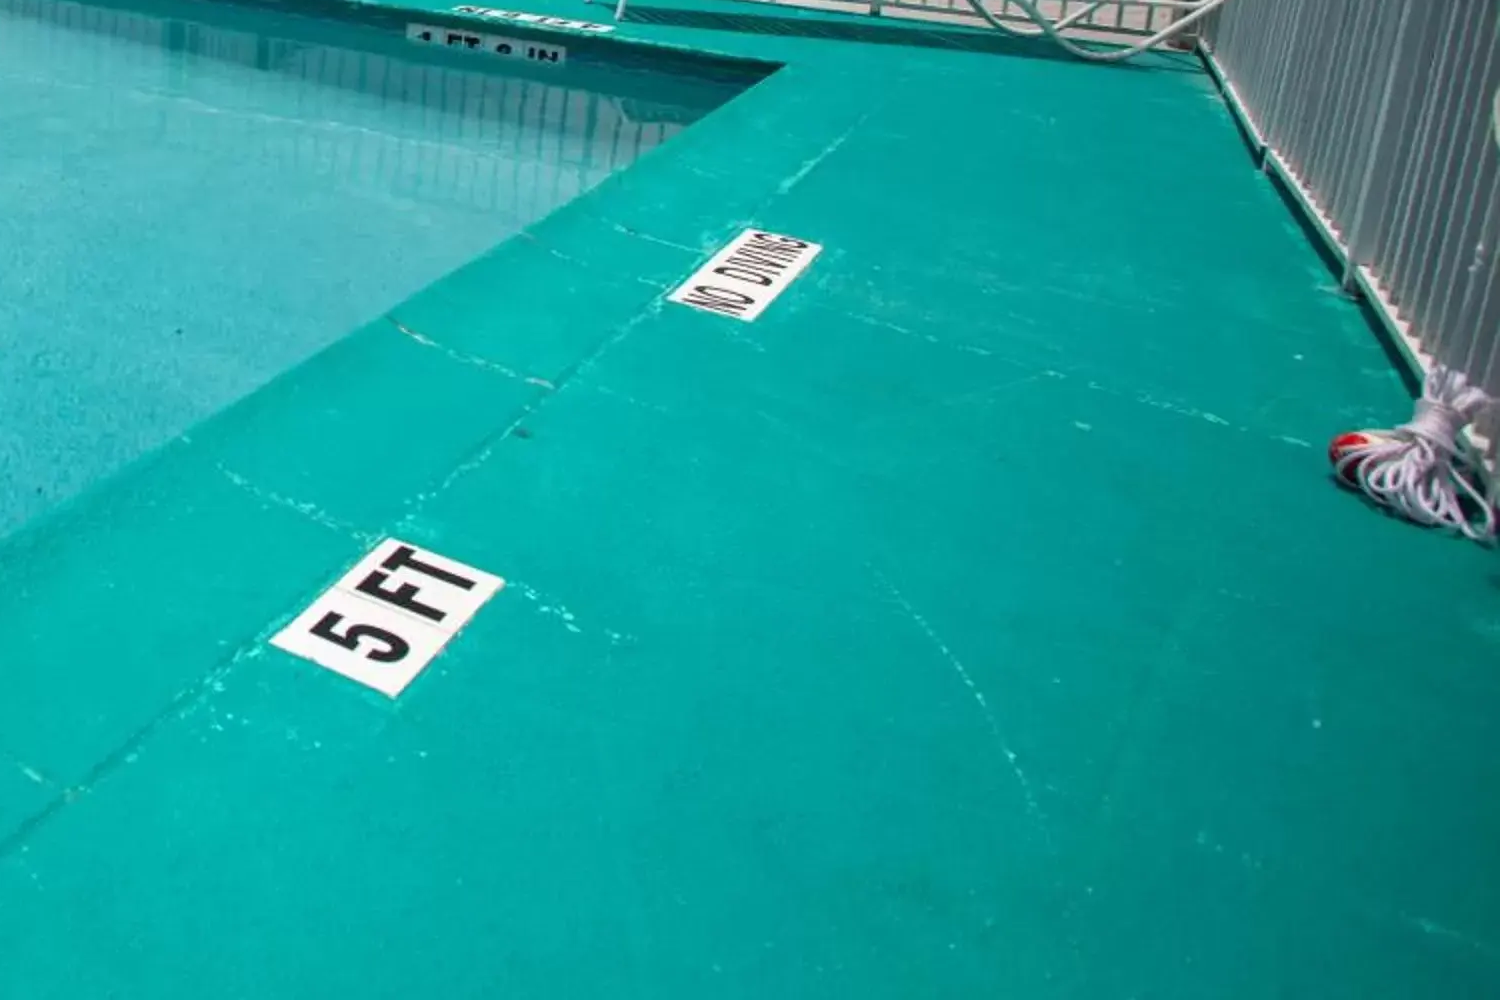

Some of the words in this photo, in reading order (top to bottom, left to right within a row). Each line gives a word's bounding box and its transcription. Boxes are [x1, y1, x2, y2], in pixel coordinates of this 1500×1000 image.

[447, 33, 481, 50] FT
[528, 46, 560, 64] IN
[712, 232, 809, 287] DIVING
[682, 285, 756, 317] NO
[355, 545, 477, 623] FT
[309, 610, 411, 664] 5
